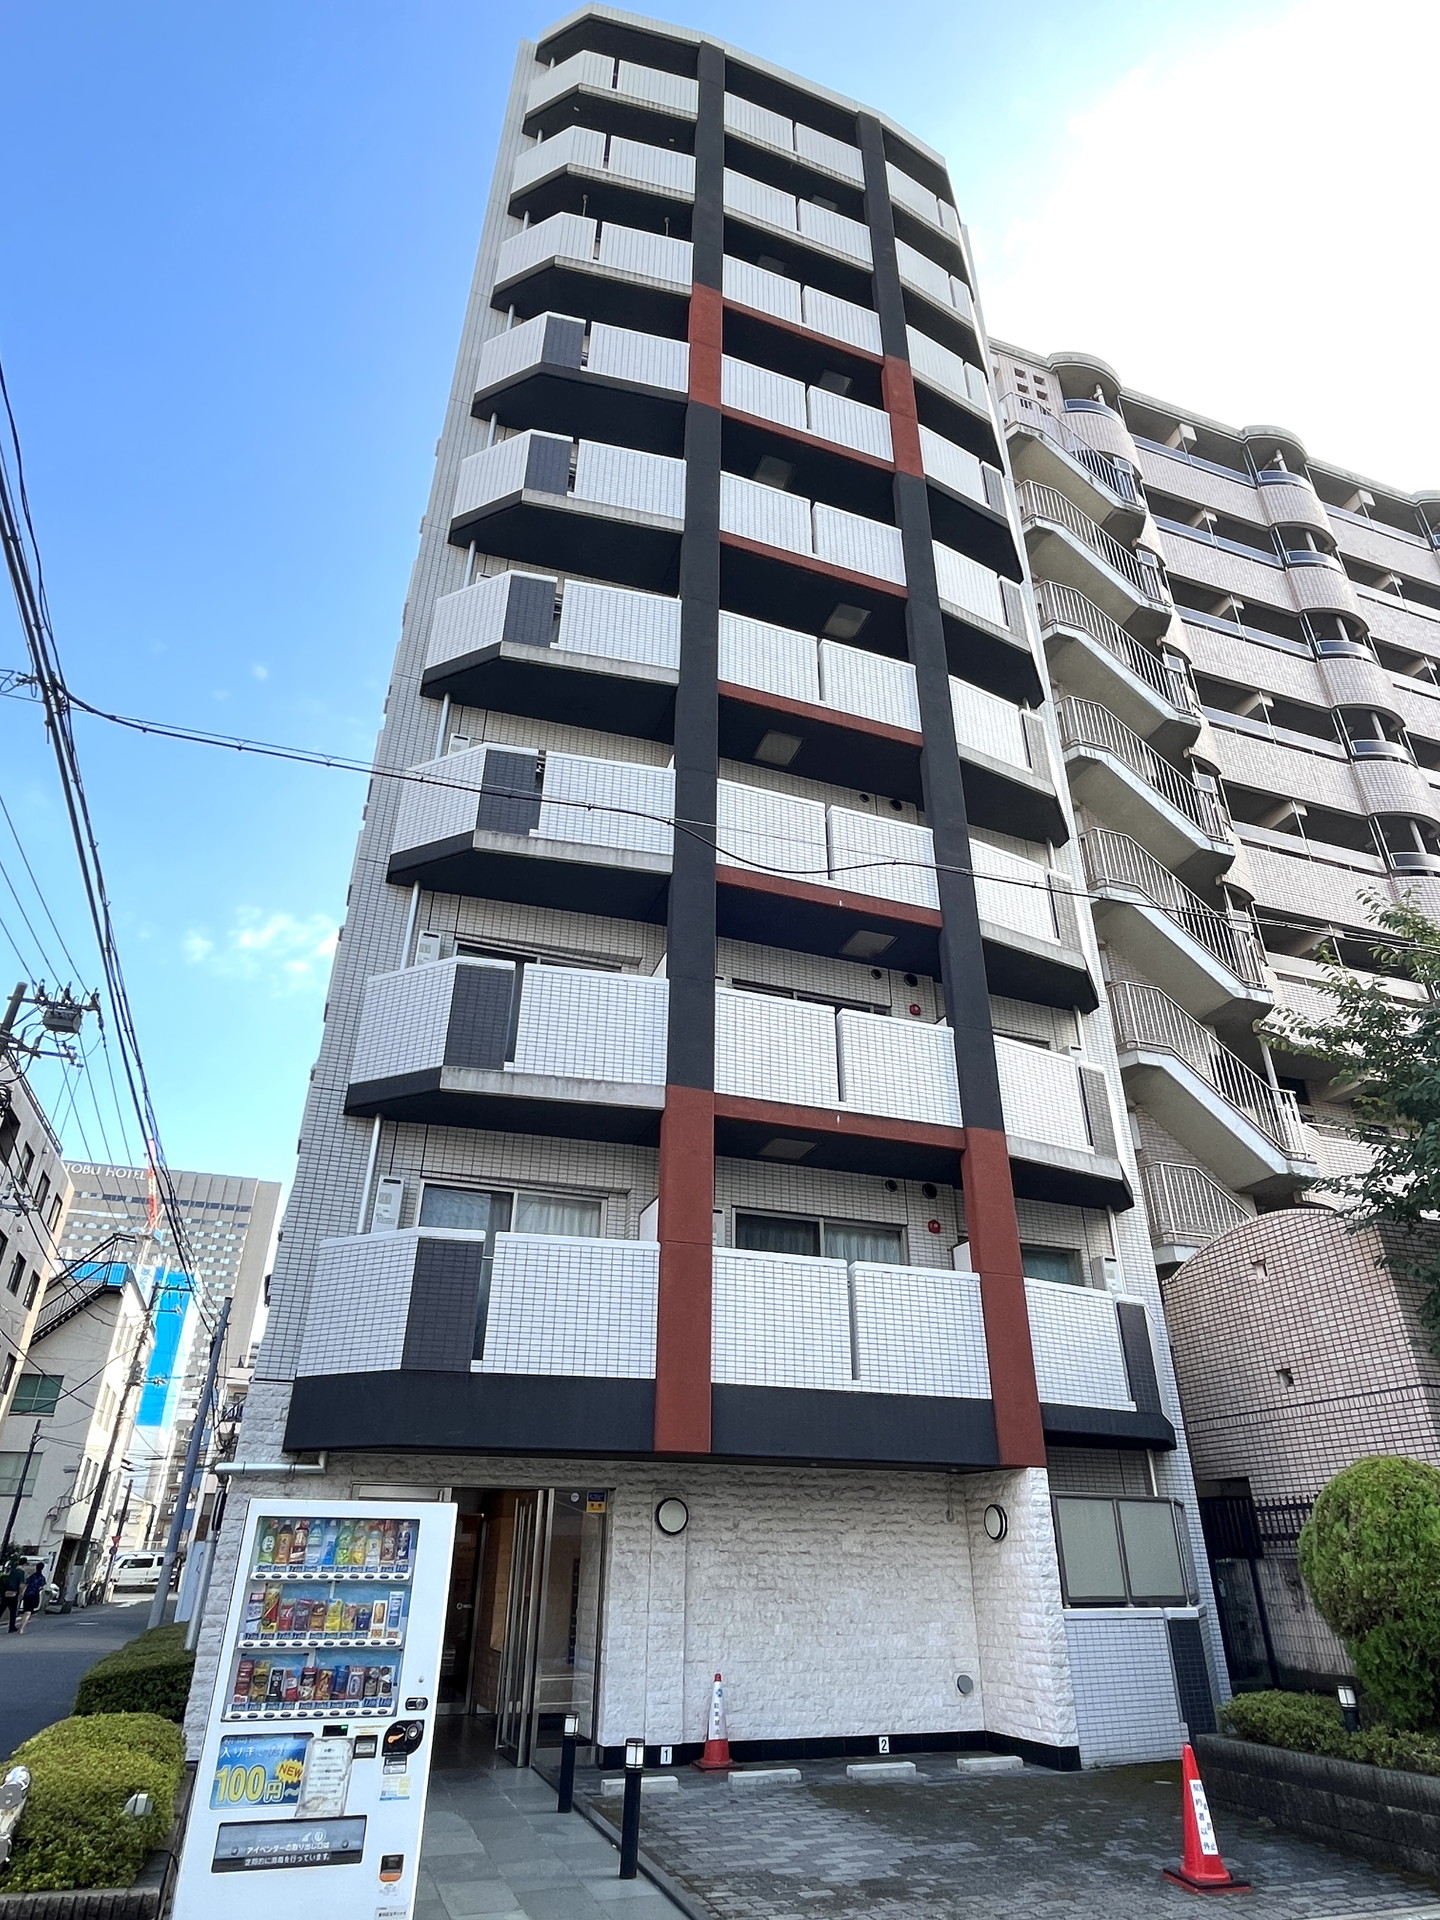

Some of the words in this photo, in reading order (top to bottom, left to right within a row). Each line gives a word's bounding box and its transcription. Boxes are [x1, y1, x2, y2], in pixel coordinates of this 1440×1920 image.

[66, 1163, 100, 1176] TOBU
[105, 1167, 147, 1181] HOTEL
[881, 1739, 887, 1751] 2
[664, 1749, 669, 1762] 1
[279, 1763, 303, 1778] NEW
